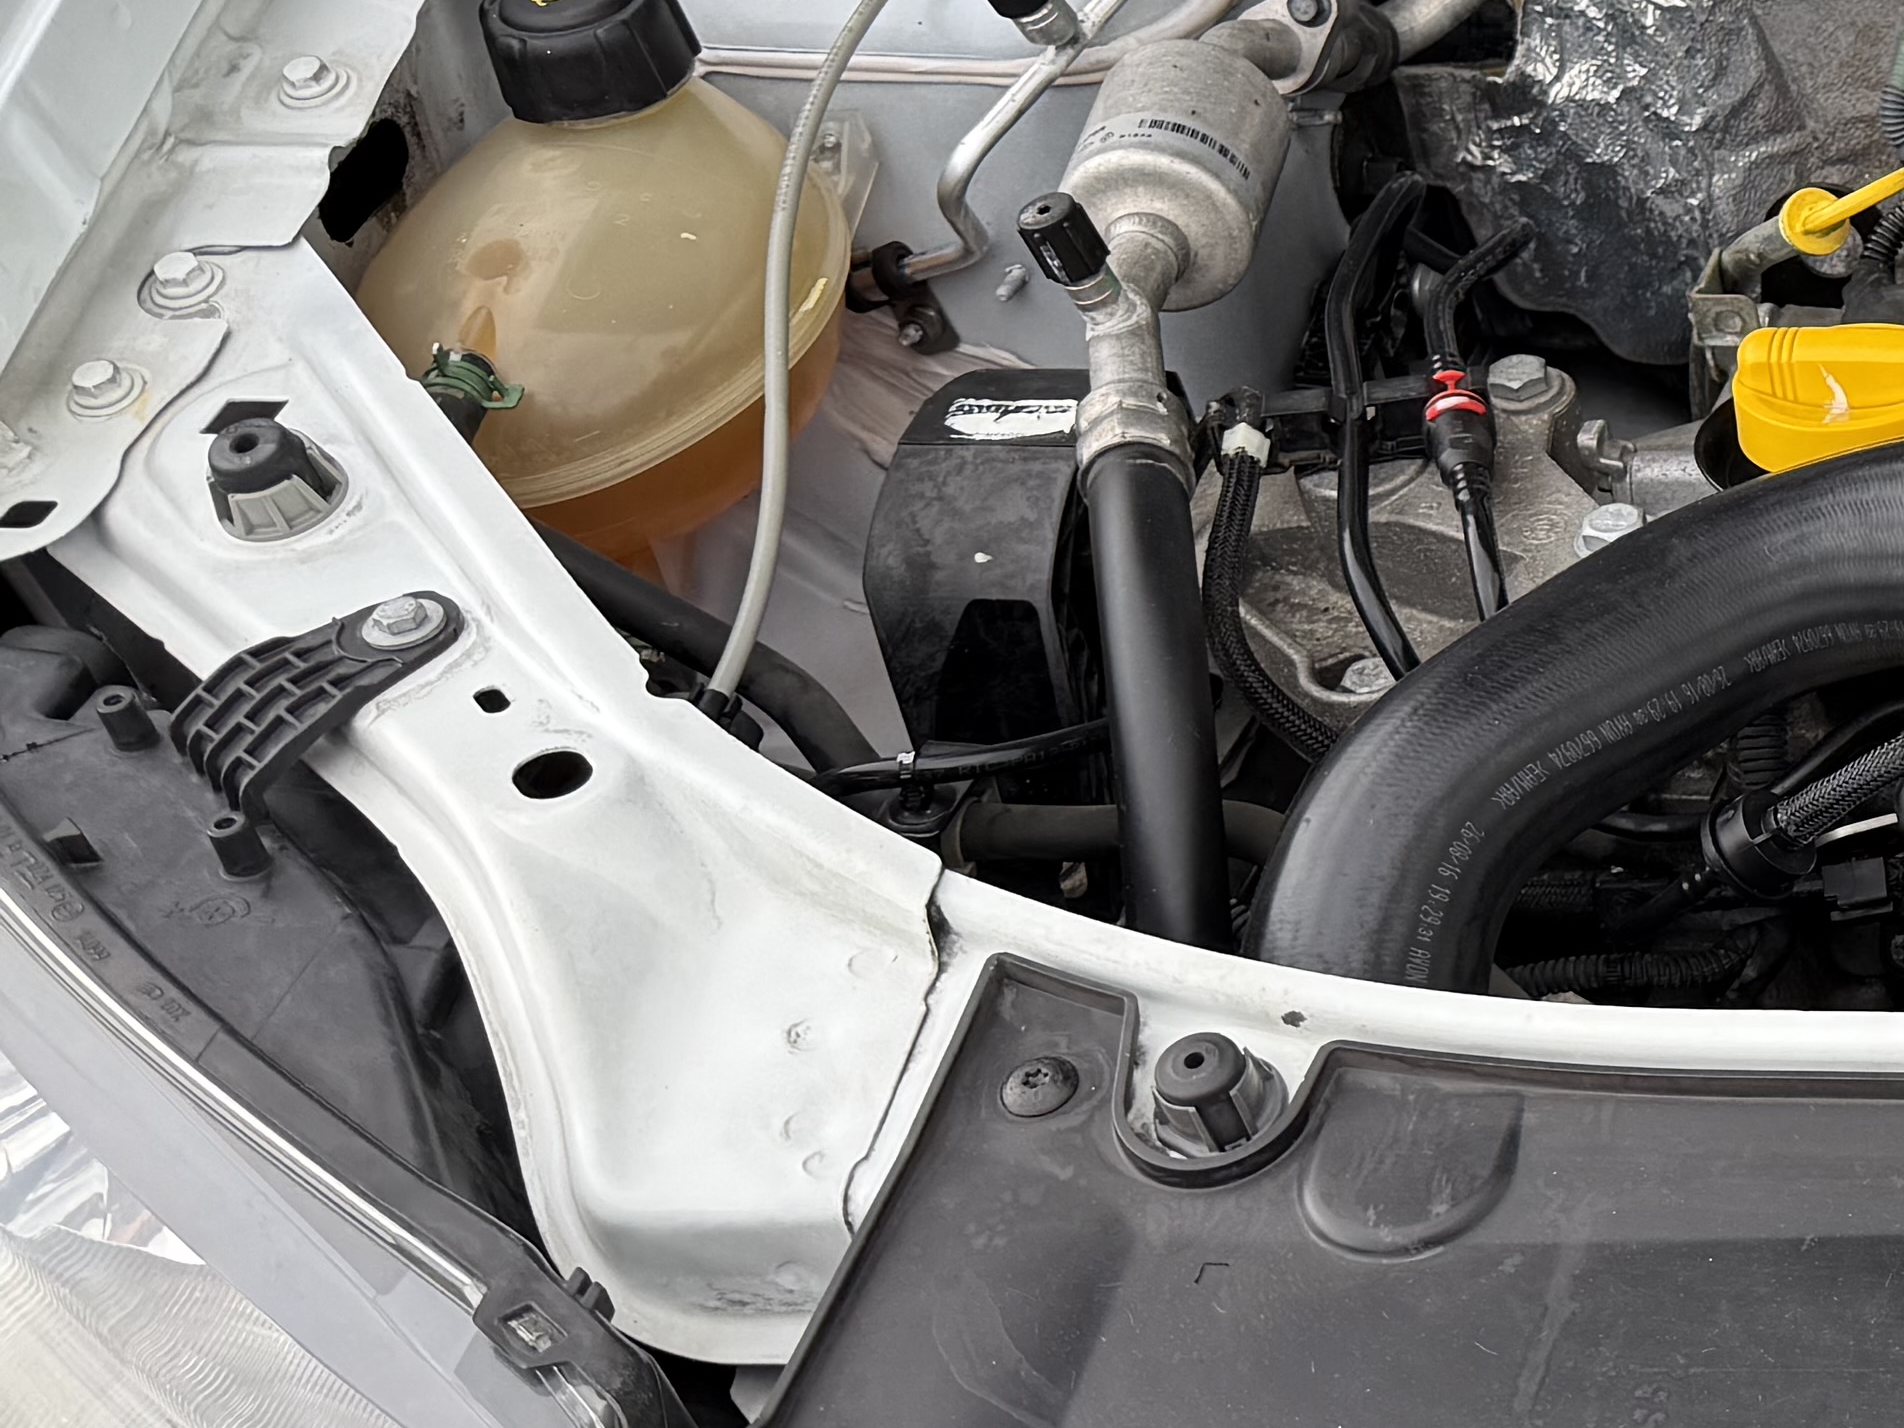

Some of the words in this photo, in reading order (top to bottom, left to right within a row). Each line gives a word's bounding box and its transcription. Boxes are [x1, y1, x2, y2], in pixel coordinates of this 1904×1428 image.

[1548, 729, 1602, 770] 6670974
[1438, 821, 1485, 881] 26/08/16
[1417, 883, 1452, 943] 19:29:31
[1405, 946, 1432, 984] AVON
